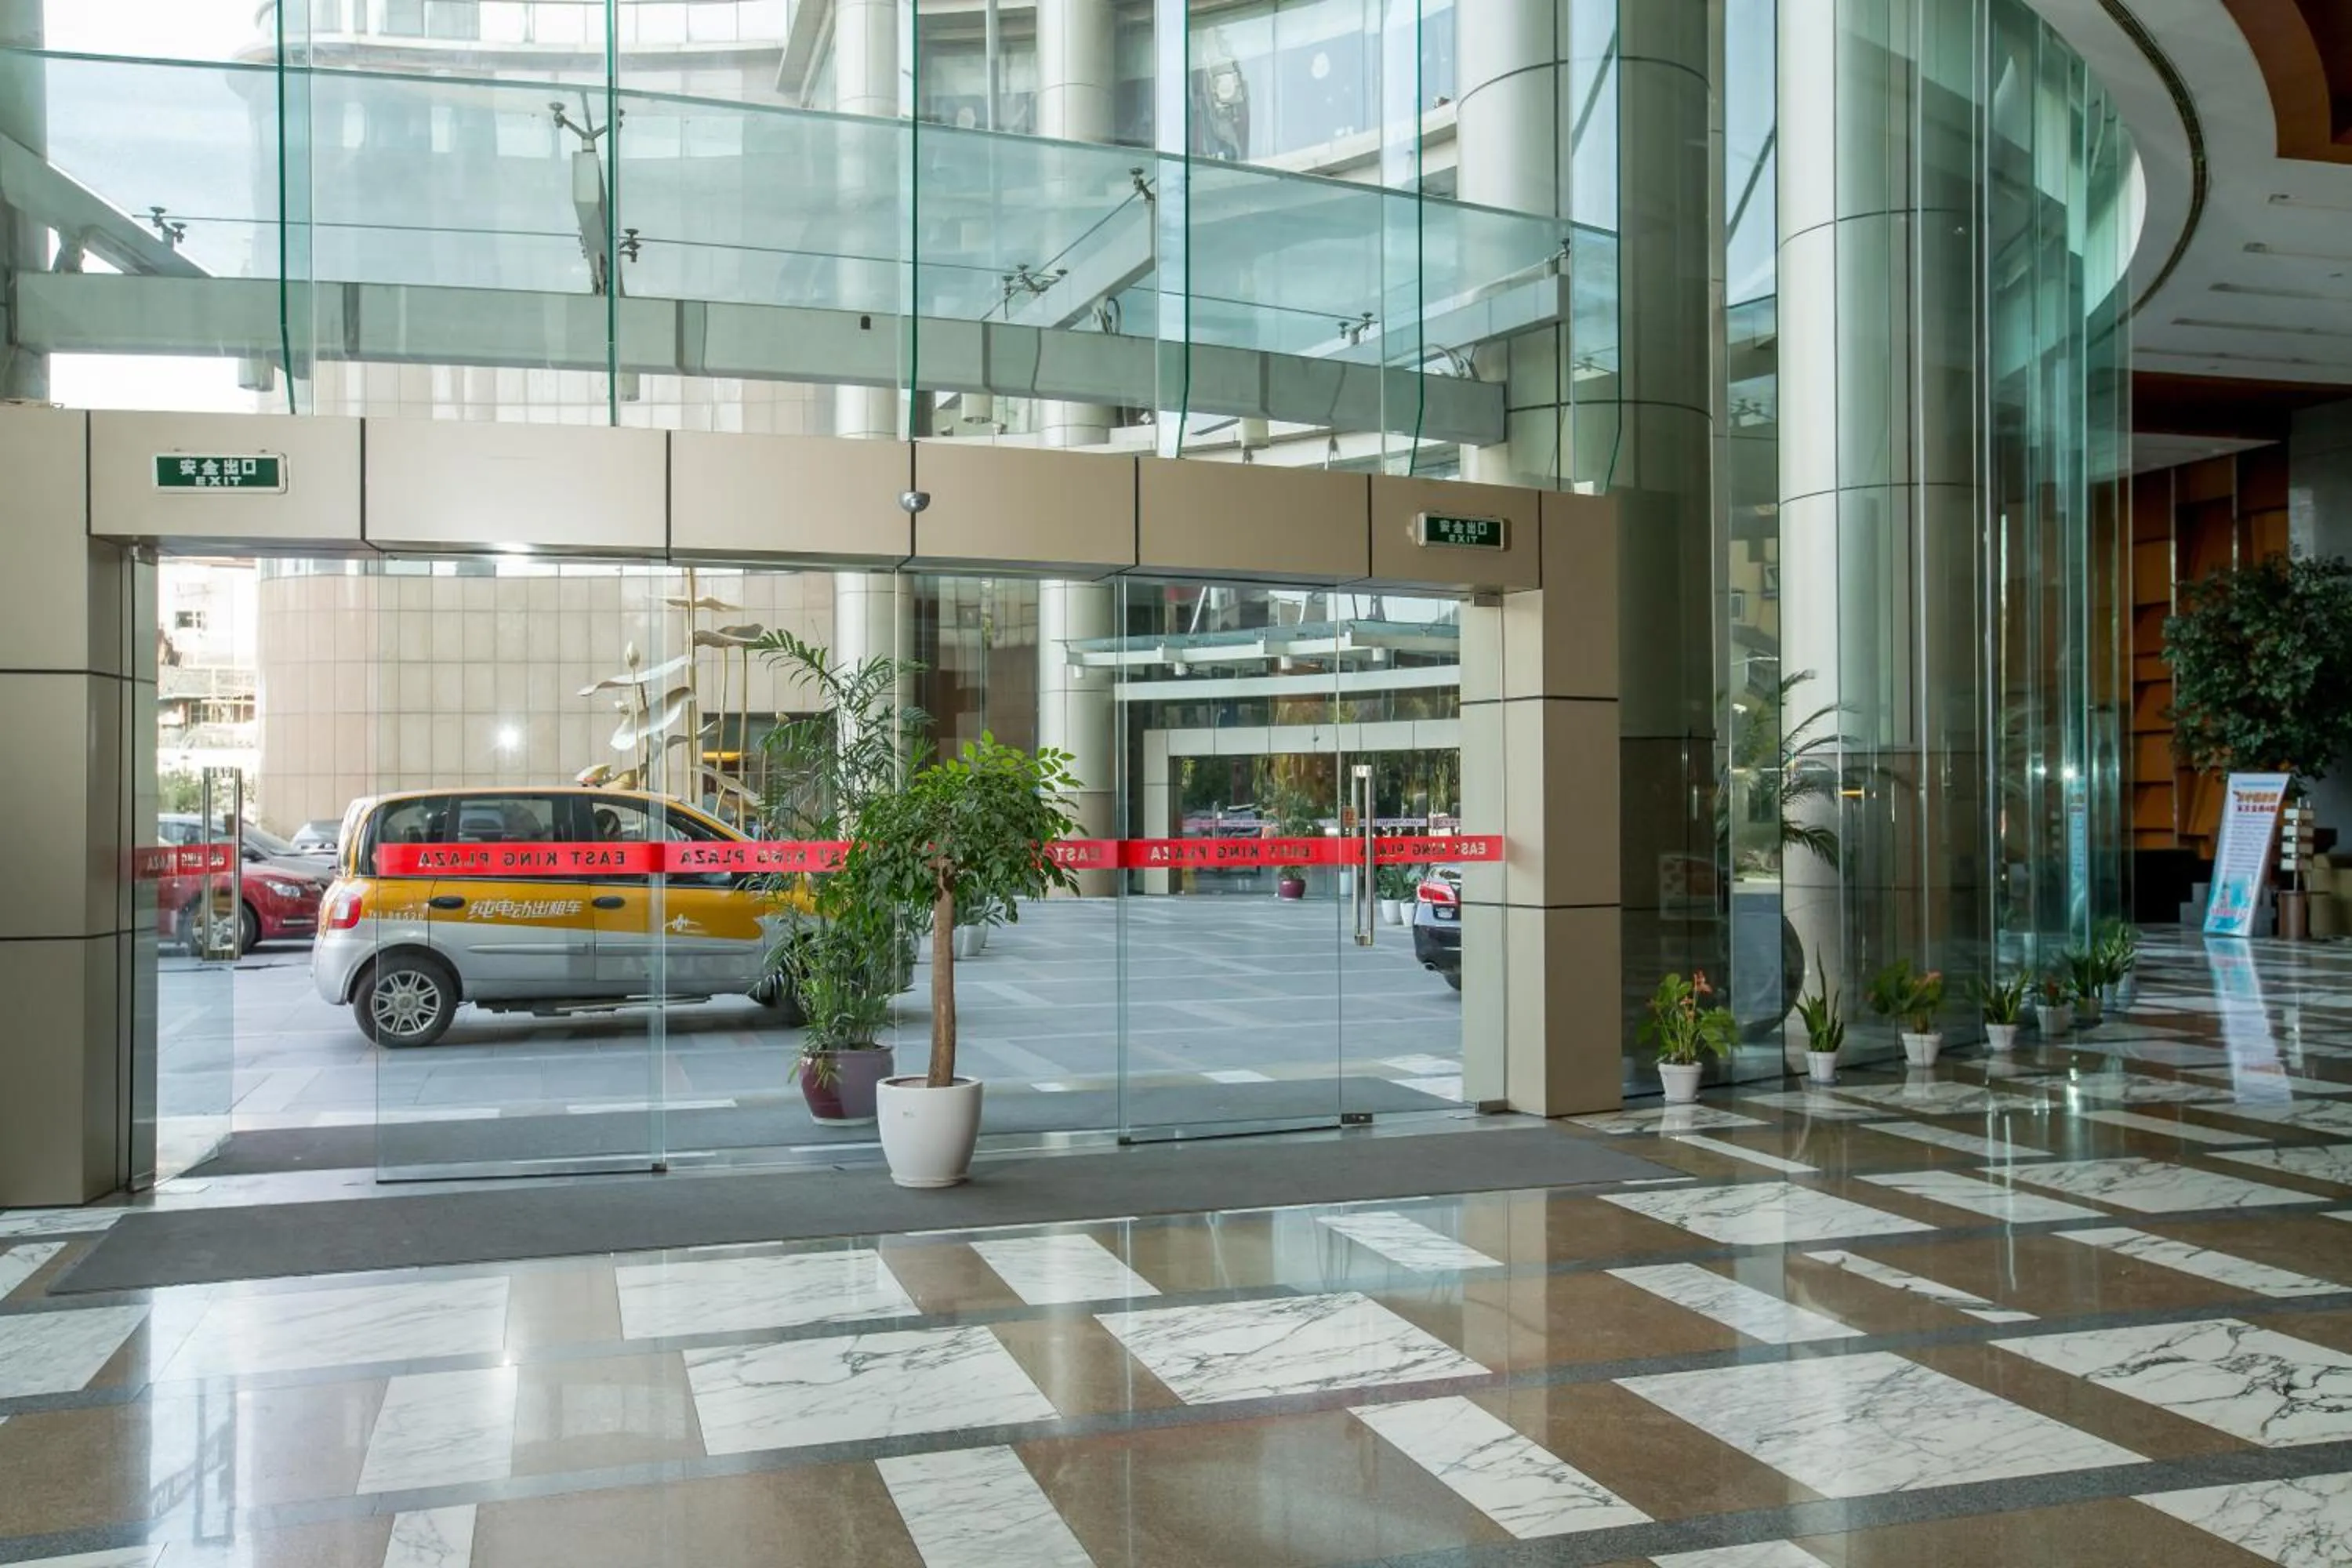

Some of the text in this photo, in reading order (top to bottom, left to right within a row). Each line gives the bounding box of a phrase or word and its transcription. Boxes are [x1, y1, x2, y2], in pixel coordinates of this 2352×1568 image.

[180, 459, 256, 475] 安全出口
[195, 476, 242, 486] EXIT
[1439, 520, 1487, 535] 安全出口
[1449, 534, 1478, 543] EXIT
[466, 899, 583, 920] 纯电动出租车
